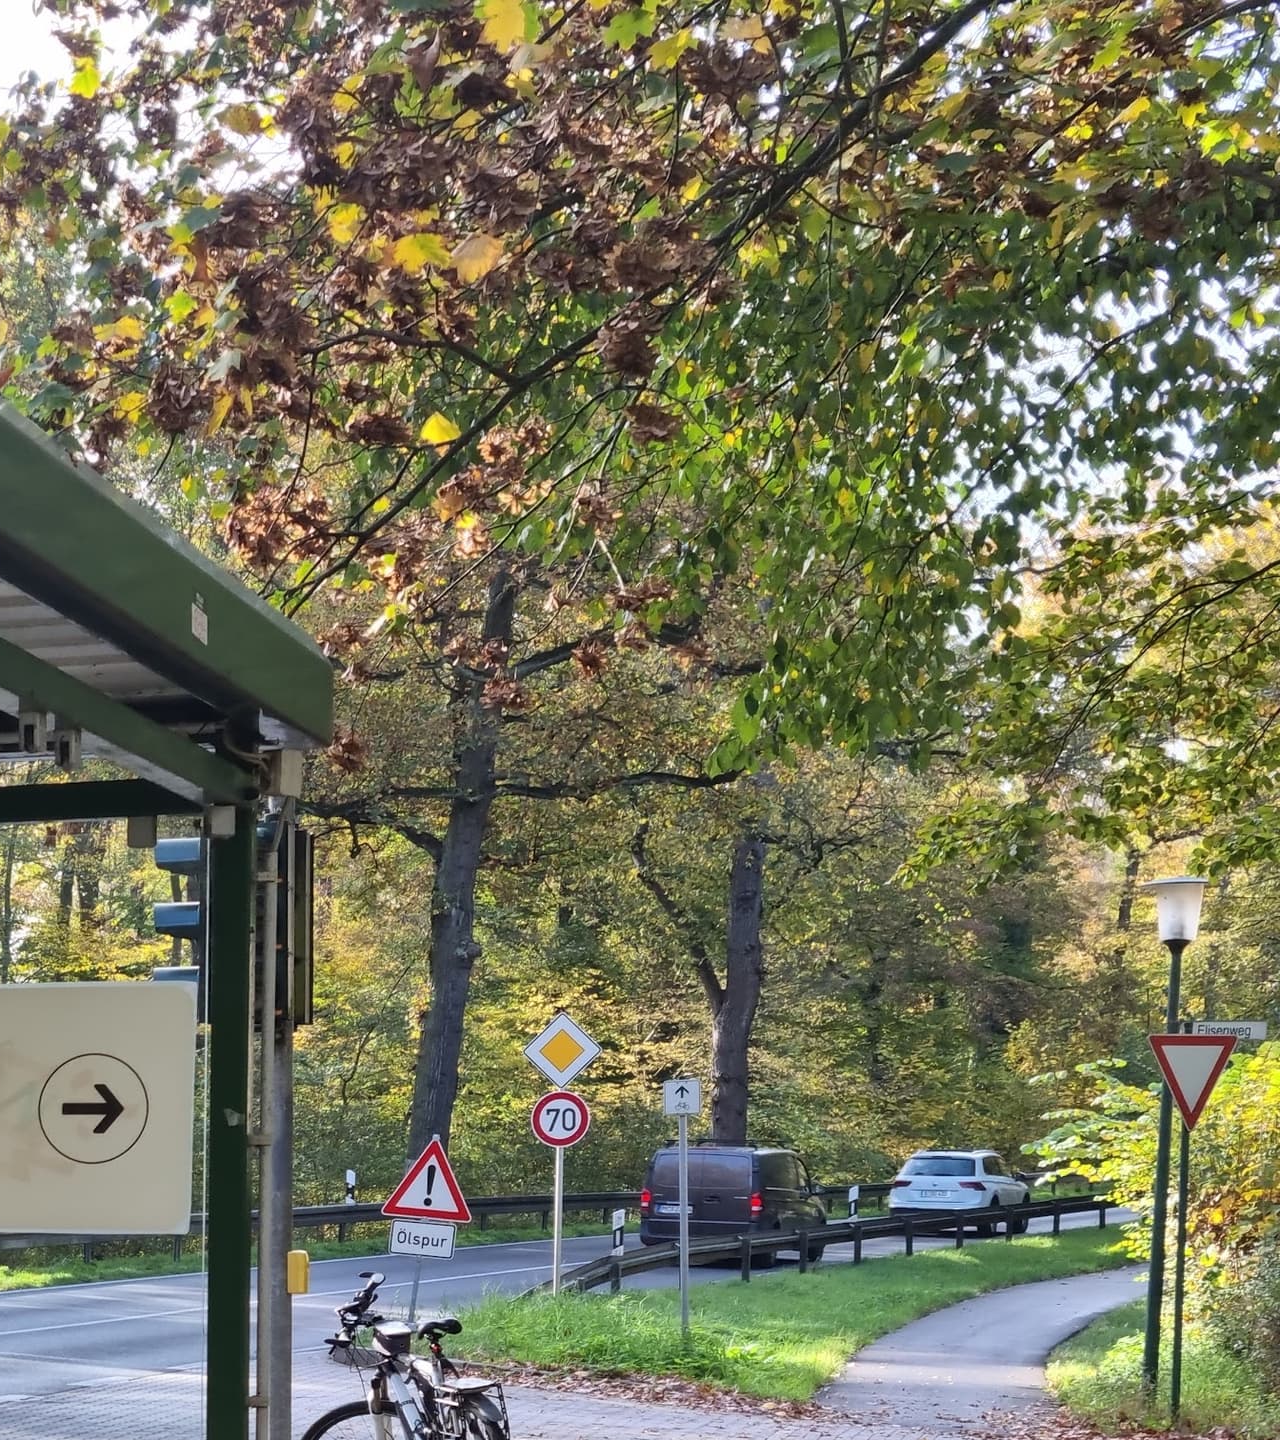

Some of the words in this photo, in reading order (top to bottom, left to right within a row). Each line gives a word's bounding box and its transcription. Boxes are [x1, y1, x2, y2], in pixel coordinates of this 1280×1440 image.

[1197, 1024, 1251, 1038] Elisenweg
[546, 1108, 576, 1132] 70
[397, 1227, 448, 1249] Ölspur
